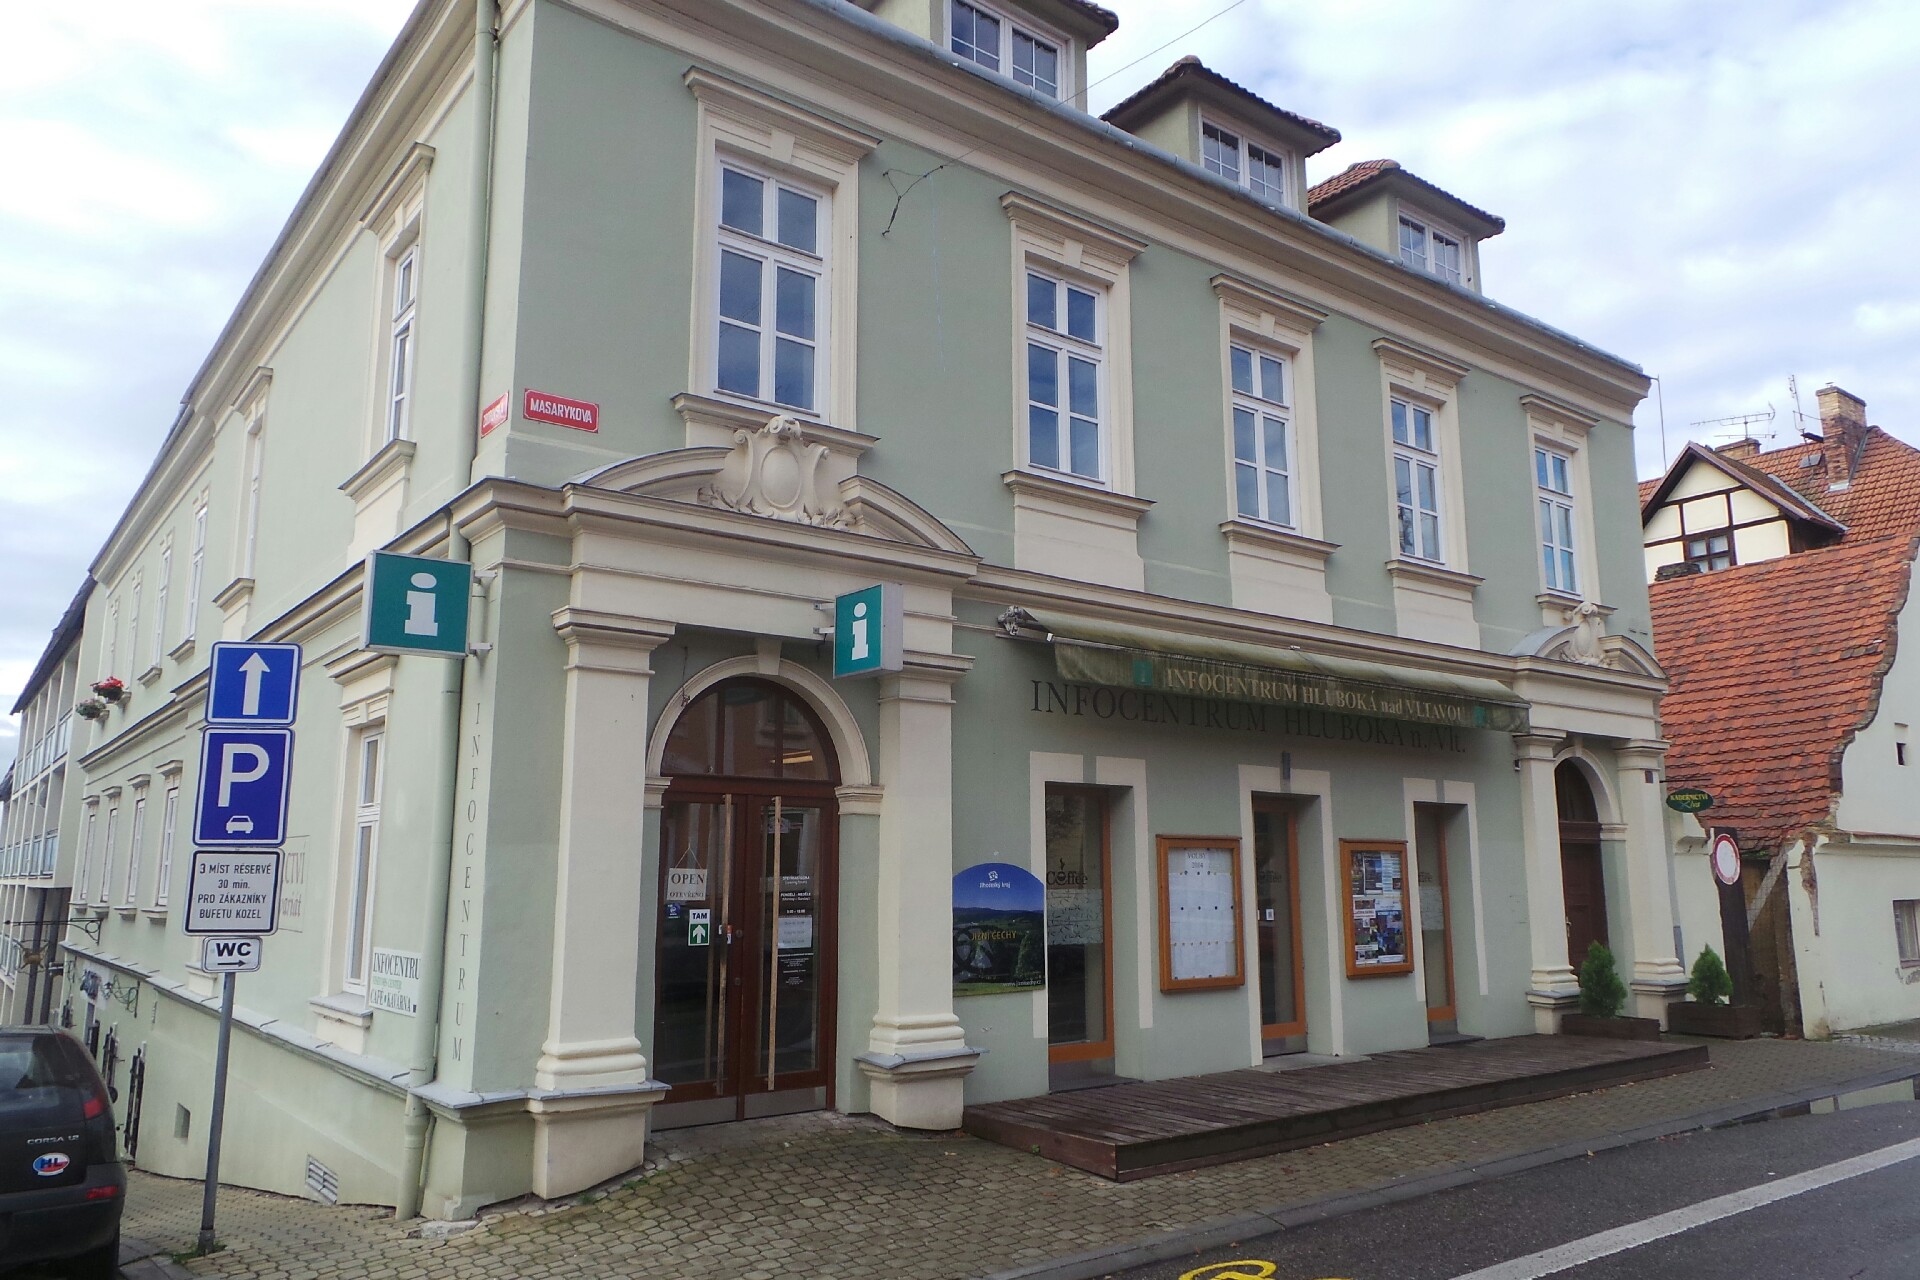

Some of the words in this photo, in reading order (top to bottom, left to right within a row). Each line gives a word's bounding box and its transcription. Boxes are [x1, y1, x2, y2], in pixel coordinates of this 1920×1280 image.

[530, 398, 592, 423] MASARYKOVA
[1167, 668, 1298, 703] INFOCENTRUM
[1302, 686, 1378, 712] HLUBOKÁ
[1381, 697, 1403, 715] nad
[1405, 699, 1465, 721] VLTAVOU
[1030, 679, 1267, 732] INFOCENTRUM
[217, 743, 270, 807] P
[199, 863, 206, 874] 3
[208, 862, 230, 874] MÍST
[218, 880, 229, 889] 30
[232, 879, 250, 889] min.
[452, 702, 481, 1062] INFOCENTRUM
[671, 873, 704, 885] OPEN
[1046, 870, 1088, 886] Coffee
[197, 893, 215, 904] PRO
[219, 892, 267, 904] ZÁKAZNÍKY
[199, 909, 232, 919] BUFETU
[235, 909, 262, 919] KOZEL
[692, 912, 708, 920] TAM
[992, 929, 1017, 940] ČECHY
[216, 942, 252, 957] WC
[373, 952, 421, 980] INFOCENTRU
[27, 1136, 64, 1144] CORSA
[41, 1157, 64, 1168] HL
